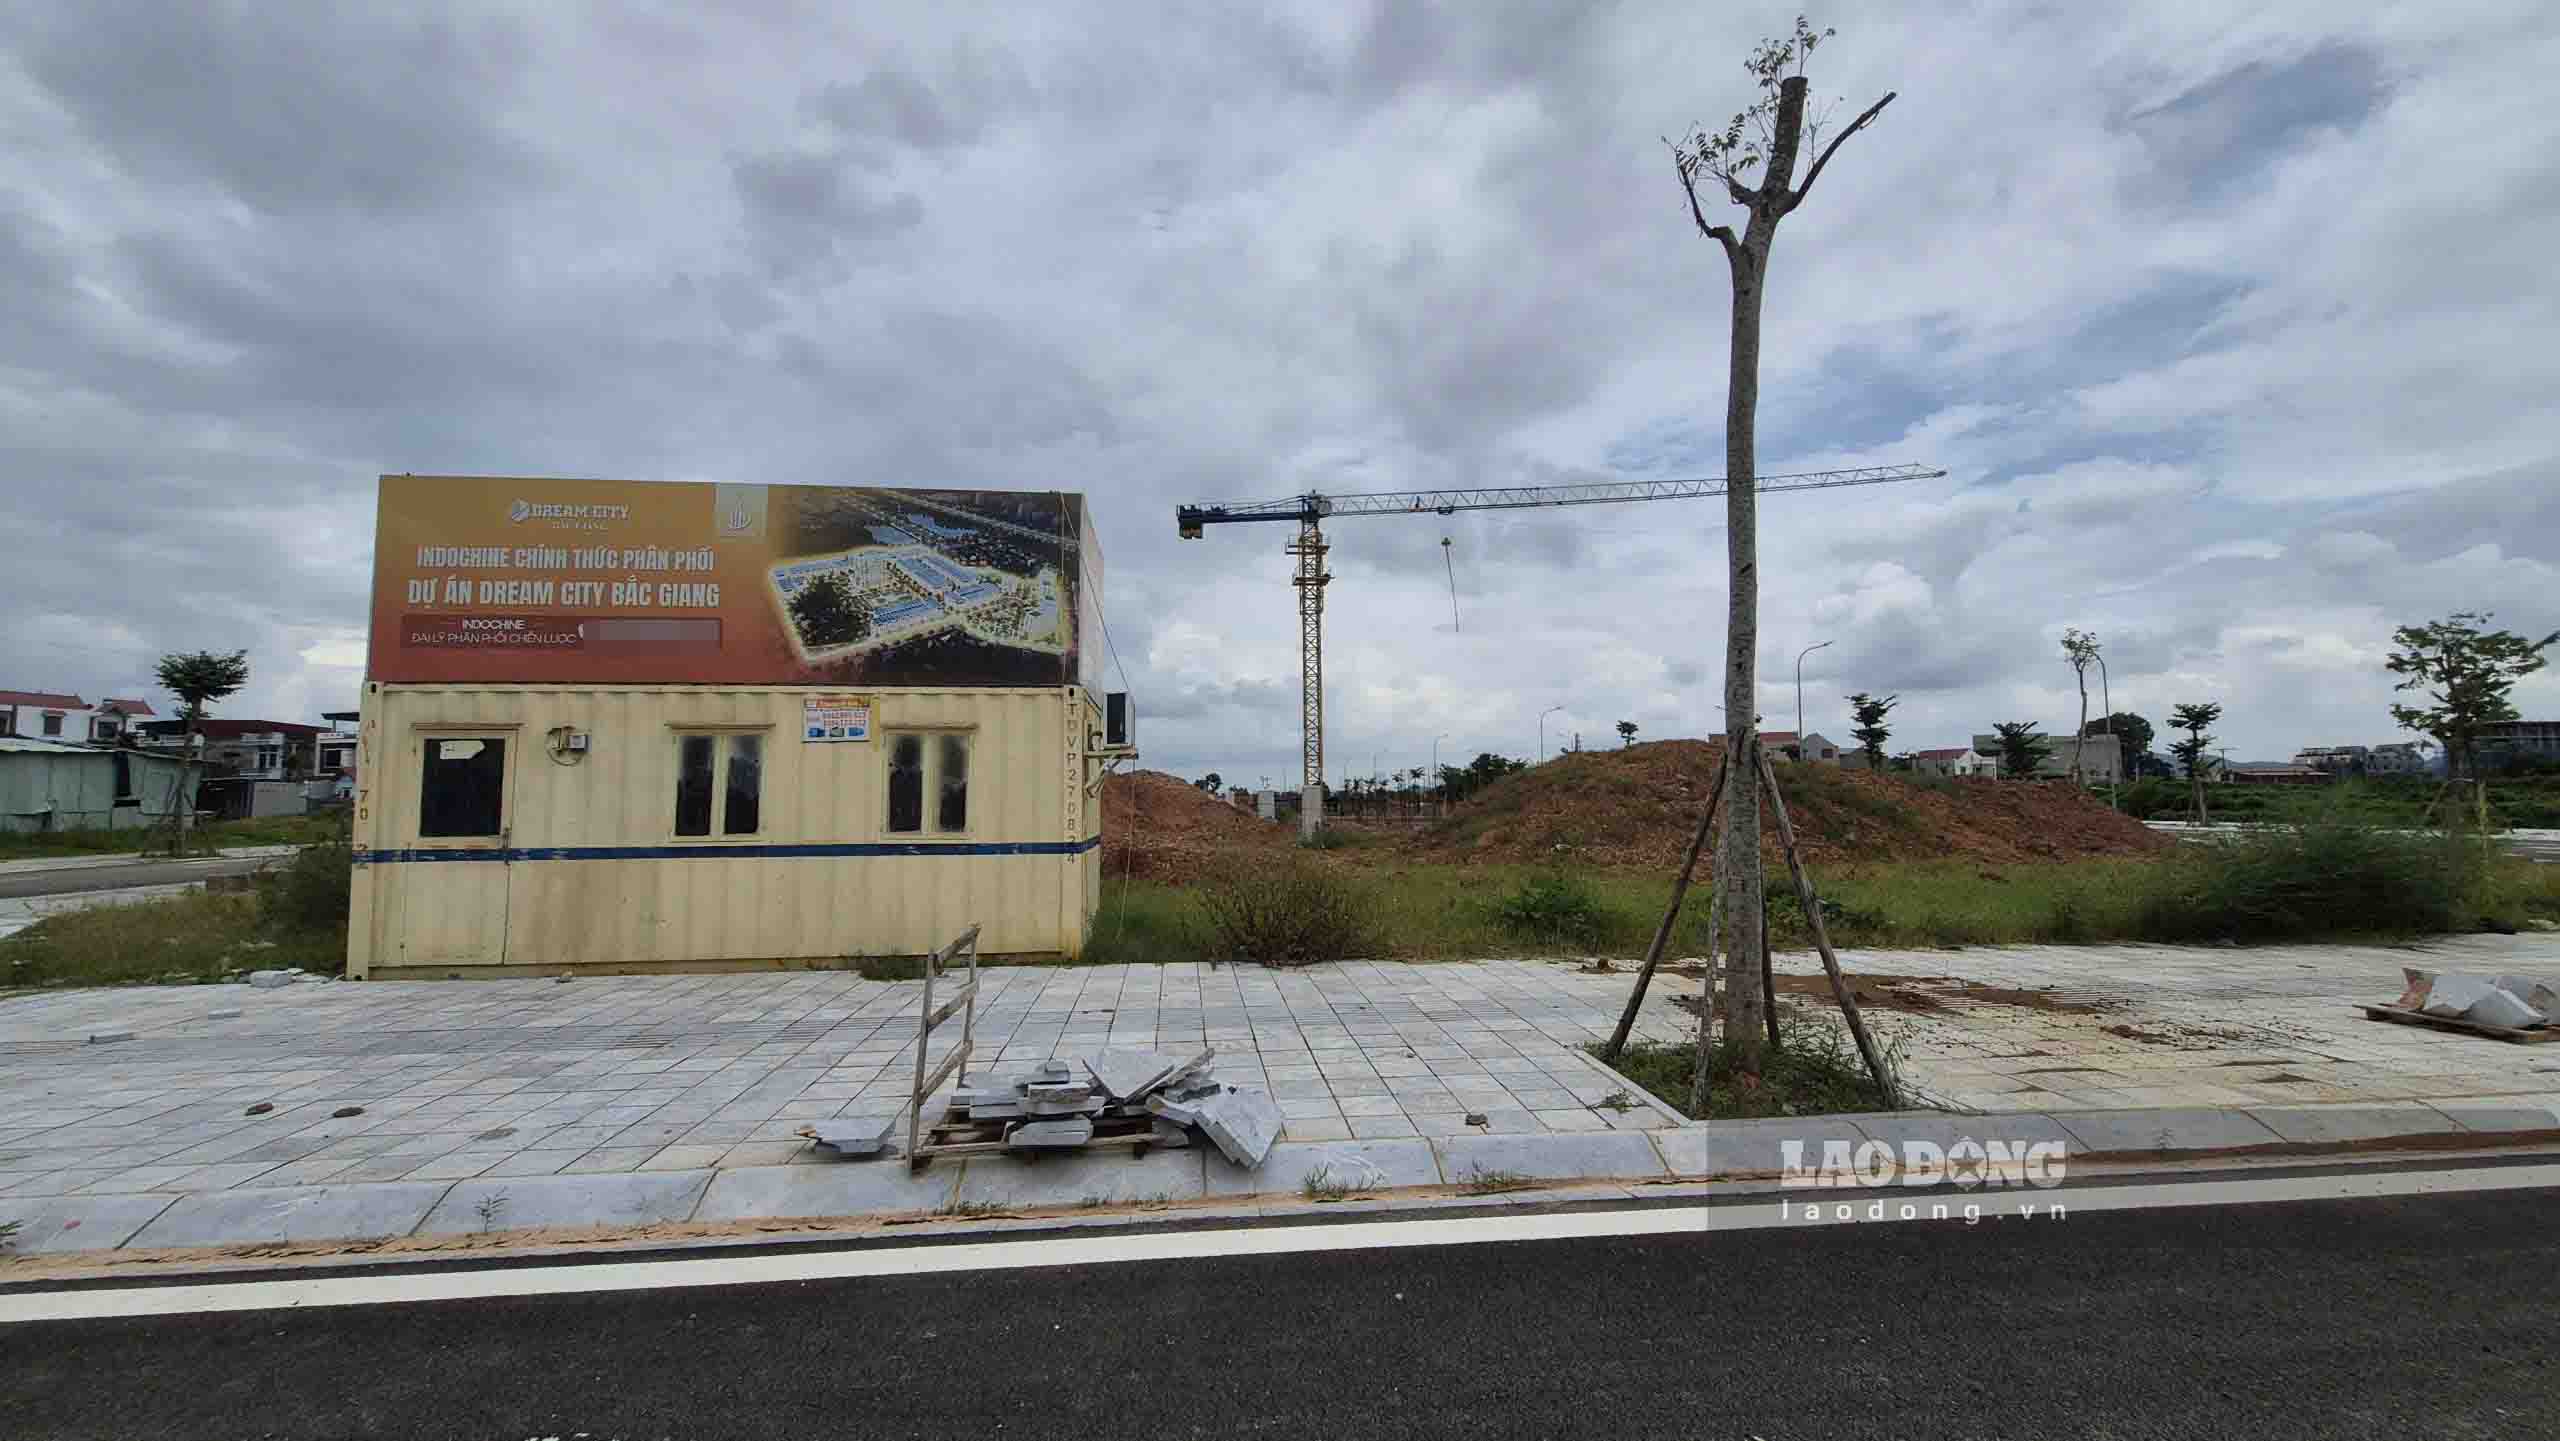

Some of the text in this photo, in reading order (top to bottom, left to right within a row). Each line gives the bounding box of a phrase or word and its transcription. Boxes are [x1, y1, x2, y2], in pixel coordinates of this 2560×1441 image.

[528, 503, 631, 519] DREAM CITY
[416, 542, 715, 571] INDOCHINE CHÍNH THỨC PHÂN PHỐI
[408, 573, 721, 609] DỰ ÁN DREAM CITY BẮC GIANG
[462, 618, 527, 631] INDOCHINE
